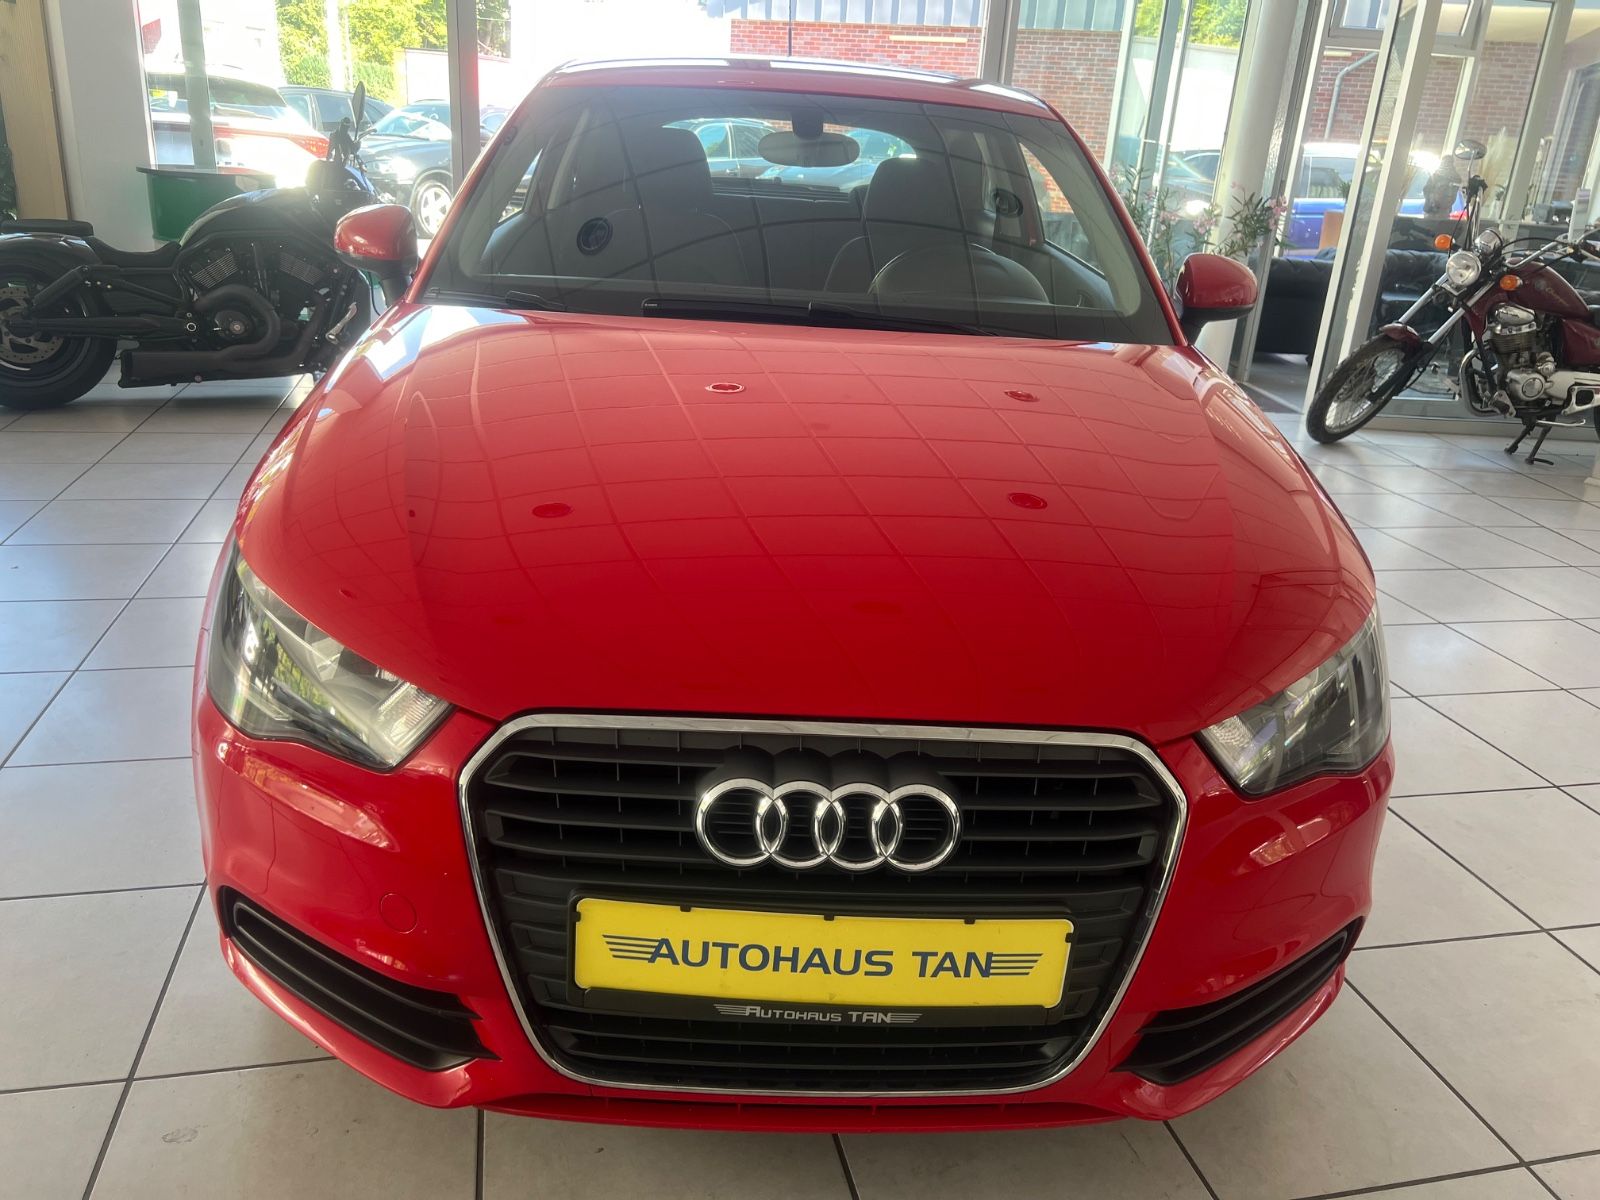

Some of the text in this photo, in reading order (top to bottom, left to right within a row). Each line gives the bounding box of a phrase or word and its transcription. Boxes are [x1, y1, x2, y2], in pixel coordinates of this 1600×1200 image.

[648, 937, 994, 978] AUTOHAUS TAN
[745, 1005, 892, 1024] AUTOHAUS TAN
